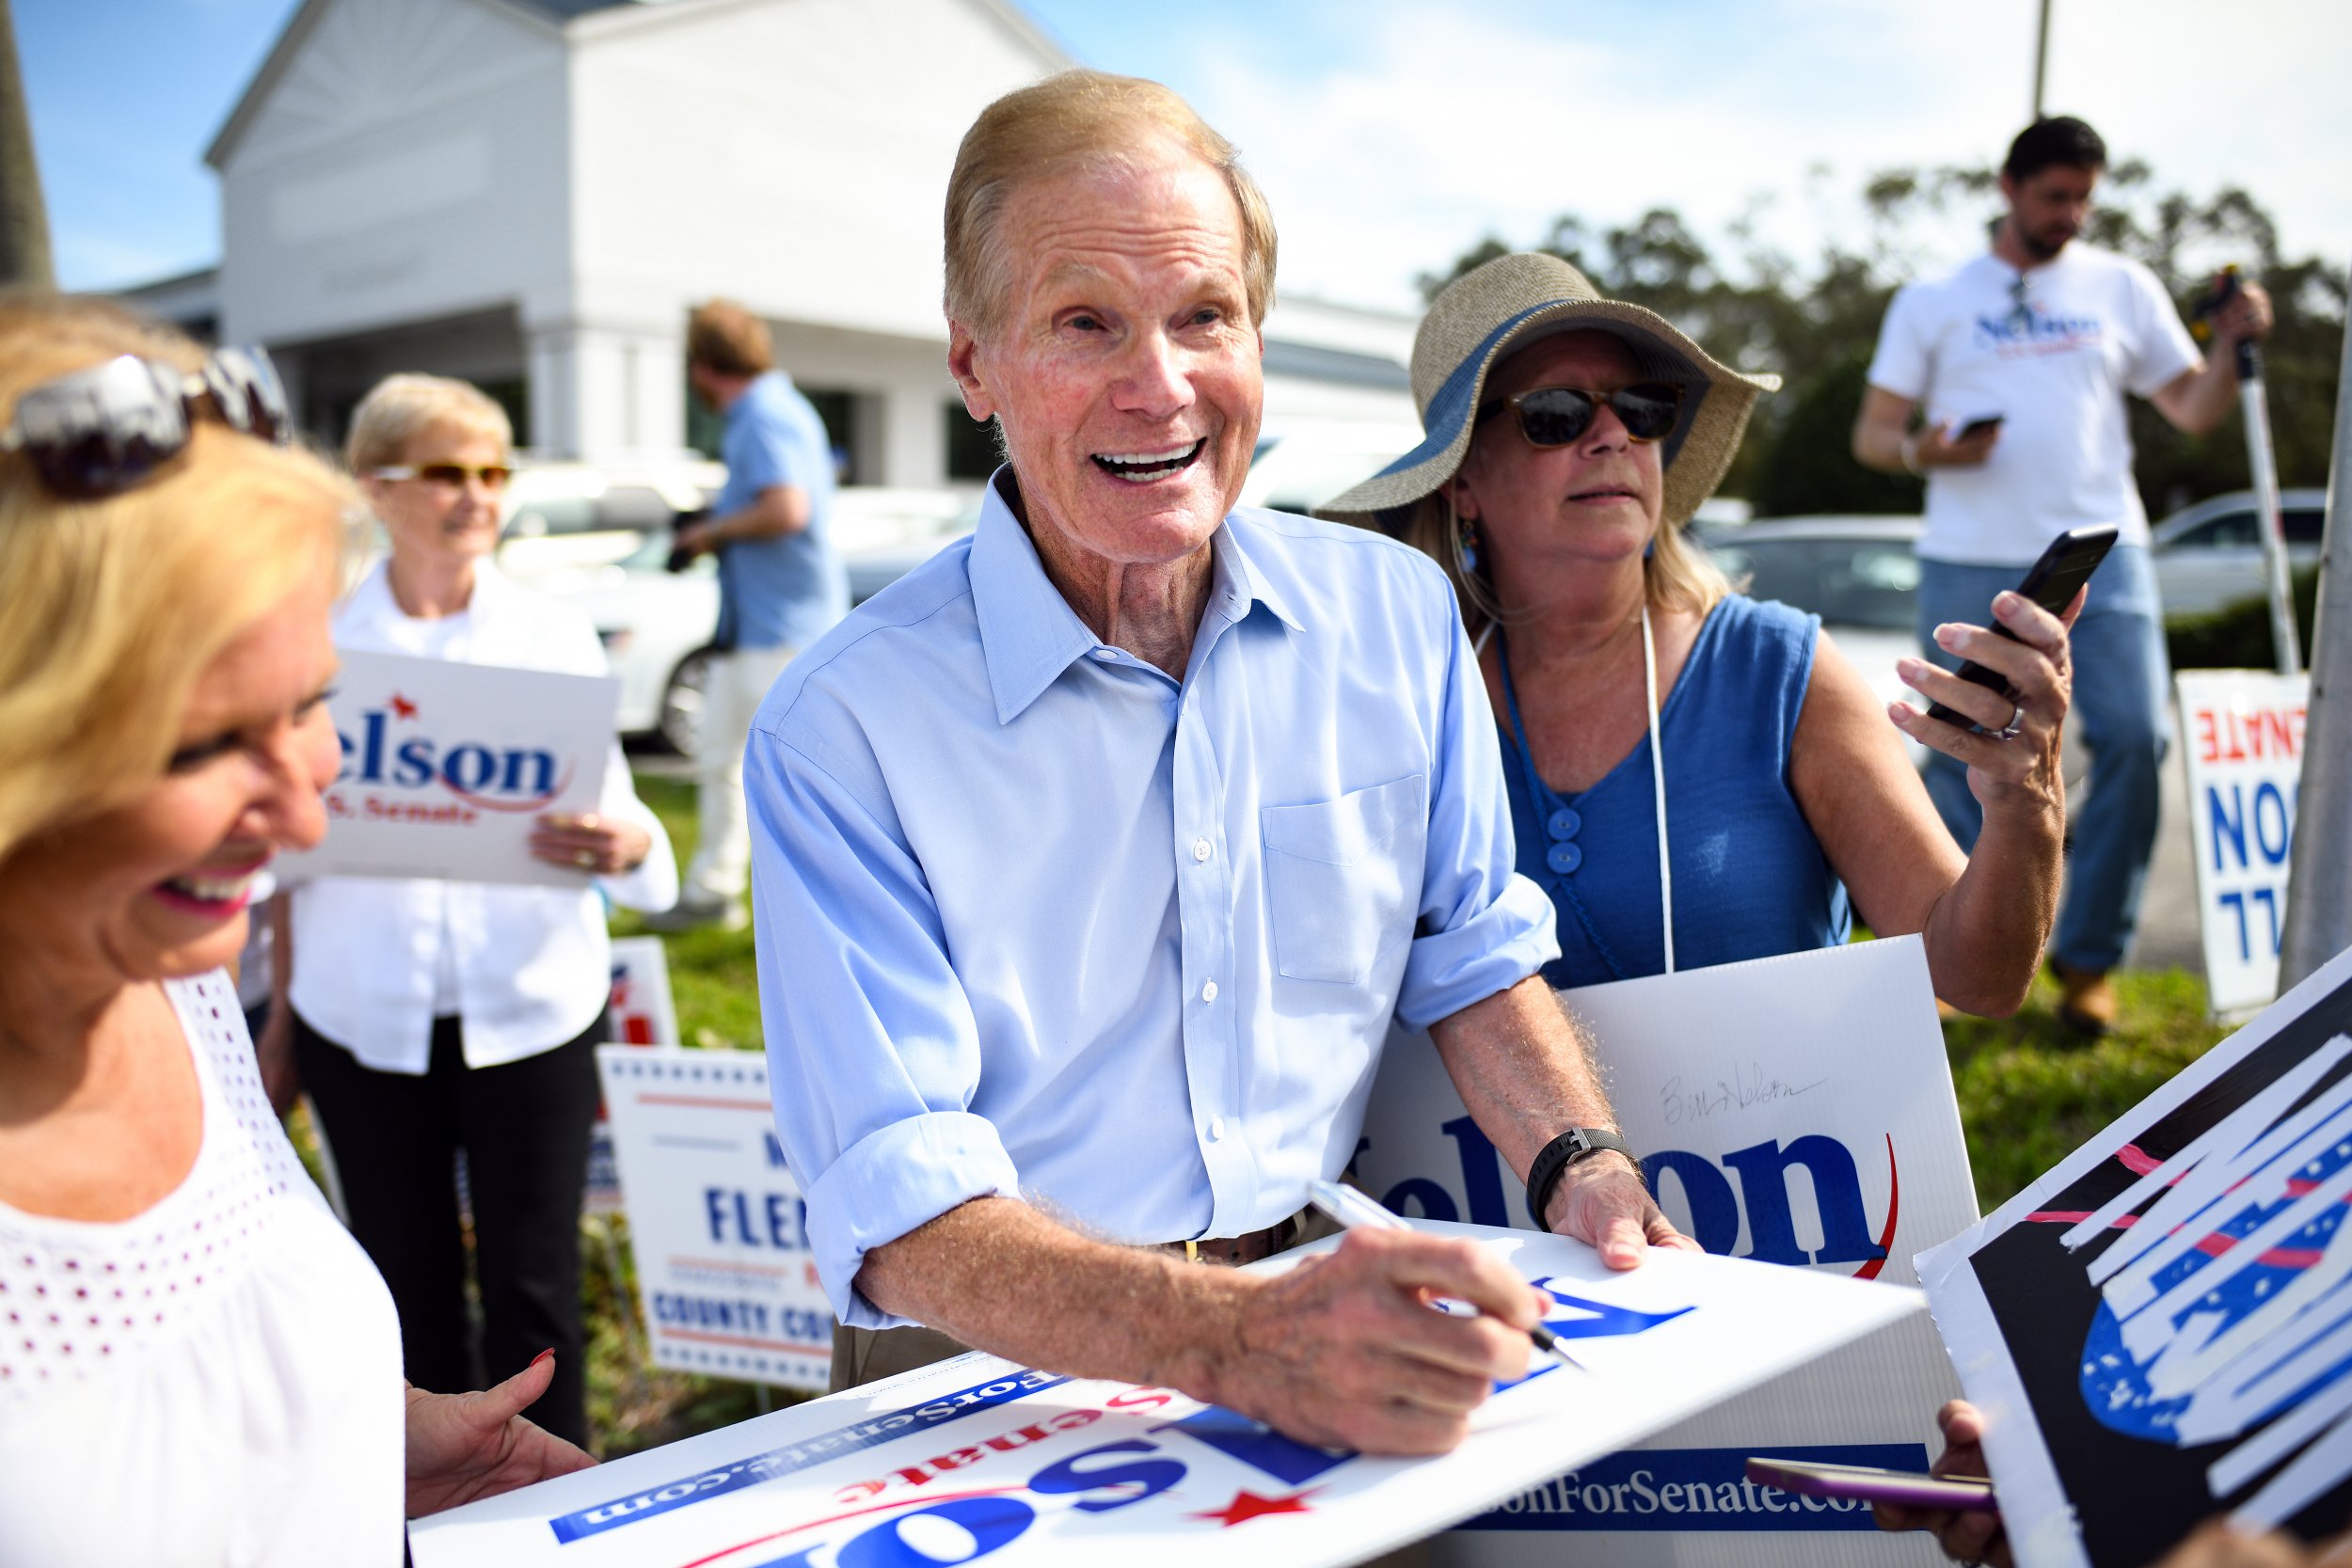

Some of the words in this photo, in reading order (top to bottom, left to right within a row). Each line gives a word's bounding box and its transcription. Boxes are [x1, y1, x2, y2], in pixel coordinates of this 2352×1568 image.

[333, 708, 556, 796] lson
[2196, 710, 2306, 762] ENATE
[2206, 782, 2298, 871] ON
[2218, 888, 2282, 961] LL
[704, 1187, 813, 1250] FLE
[654, 1291, 770, 1334] COUNTY
[580, 1370, 1065, 1525] ForSenate.com
[833, 1386, 1172, 1503] Senate
[1484, 1470, 1875, 1513] onForSenate.co
